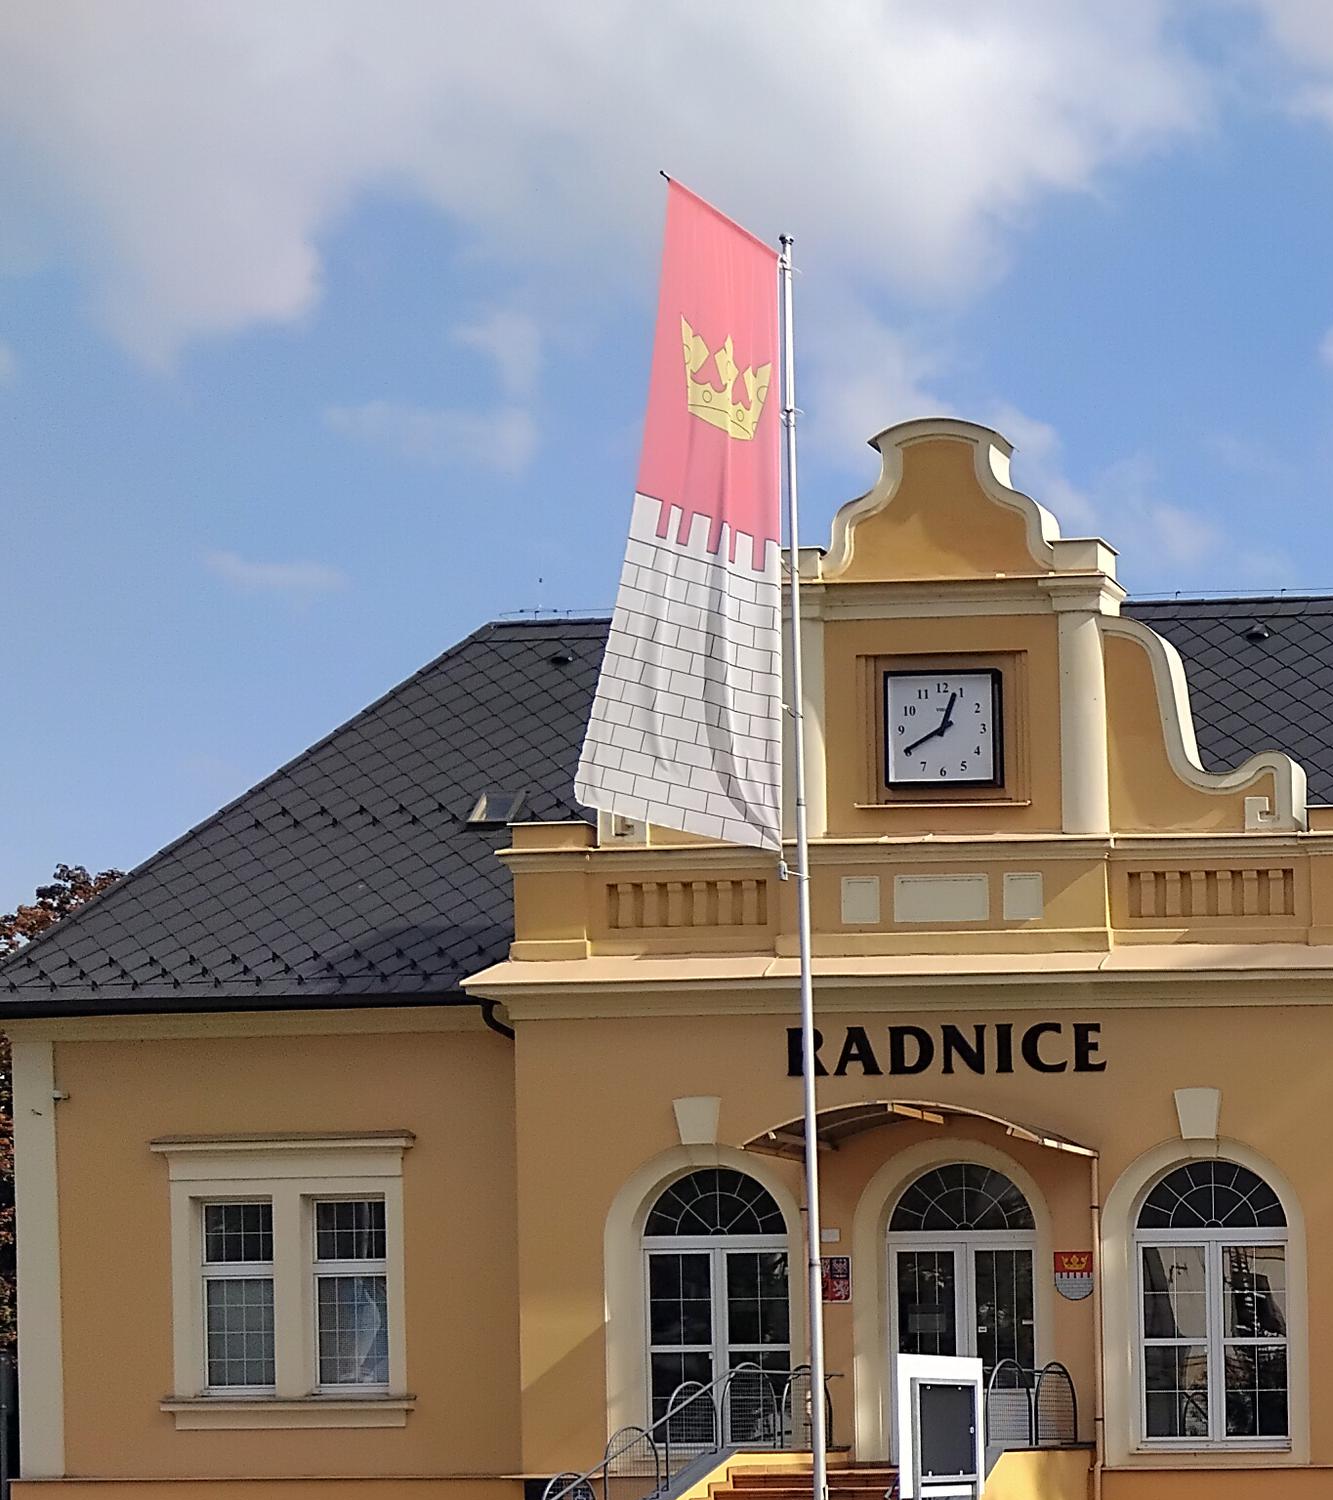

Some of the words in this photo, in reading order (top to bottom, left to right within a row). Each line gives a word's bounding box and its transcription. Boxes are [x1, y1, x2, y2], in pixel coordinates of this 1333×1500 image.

[936, 682, 949, 693] 12
[917, 689, 929, 699] 11
[903, 706, 916, 716] 10
[974, 703, 981, 713] 2
[897, 725, 905, 735] 9
[980, 723, 987, 734] 3
[973, 746, 981, 755] 4
[920, 761, 927, 771] 7
[960, 761, 967, 771] 5
[939, 767, 947, 777] 6
[786, 1022, 1107, 1076] RADNICE
